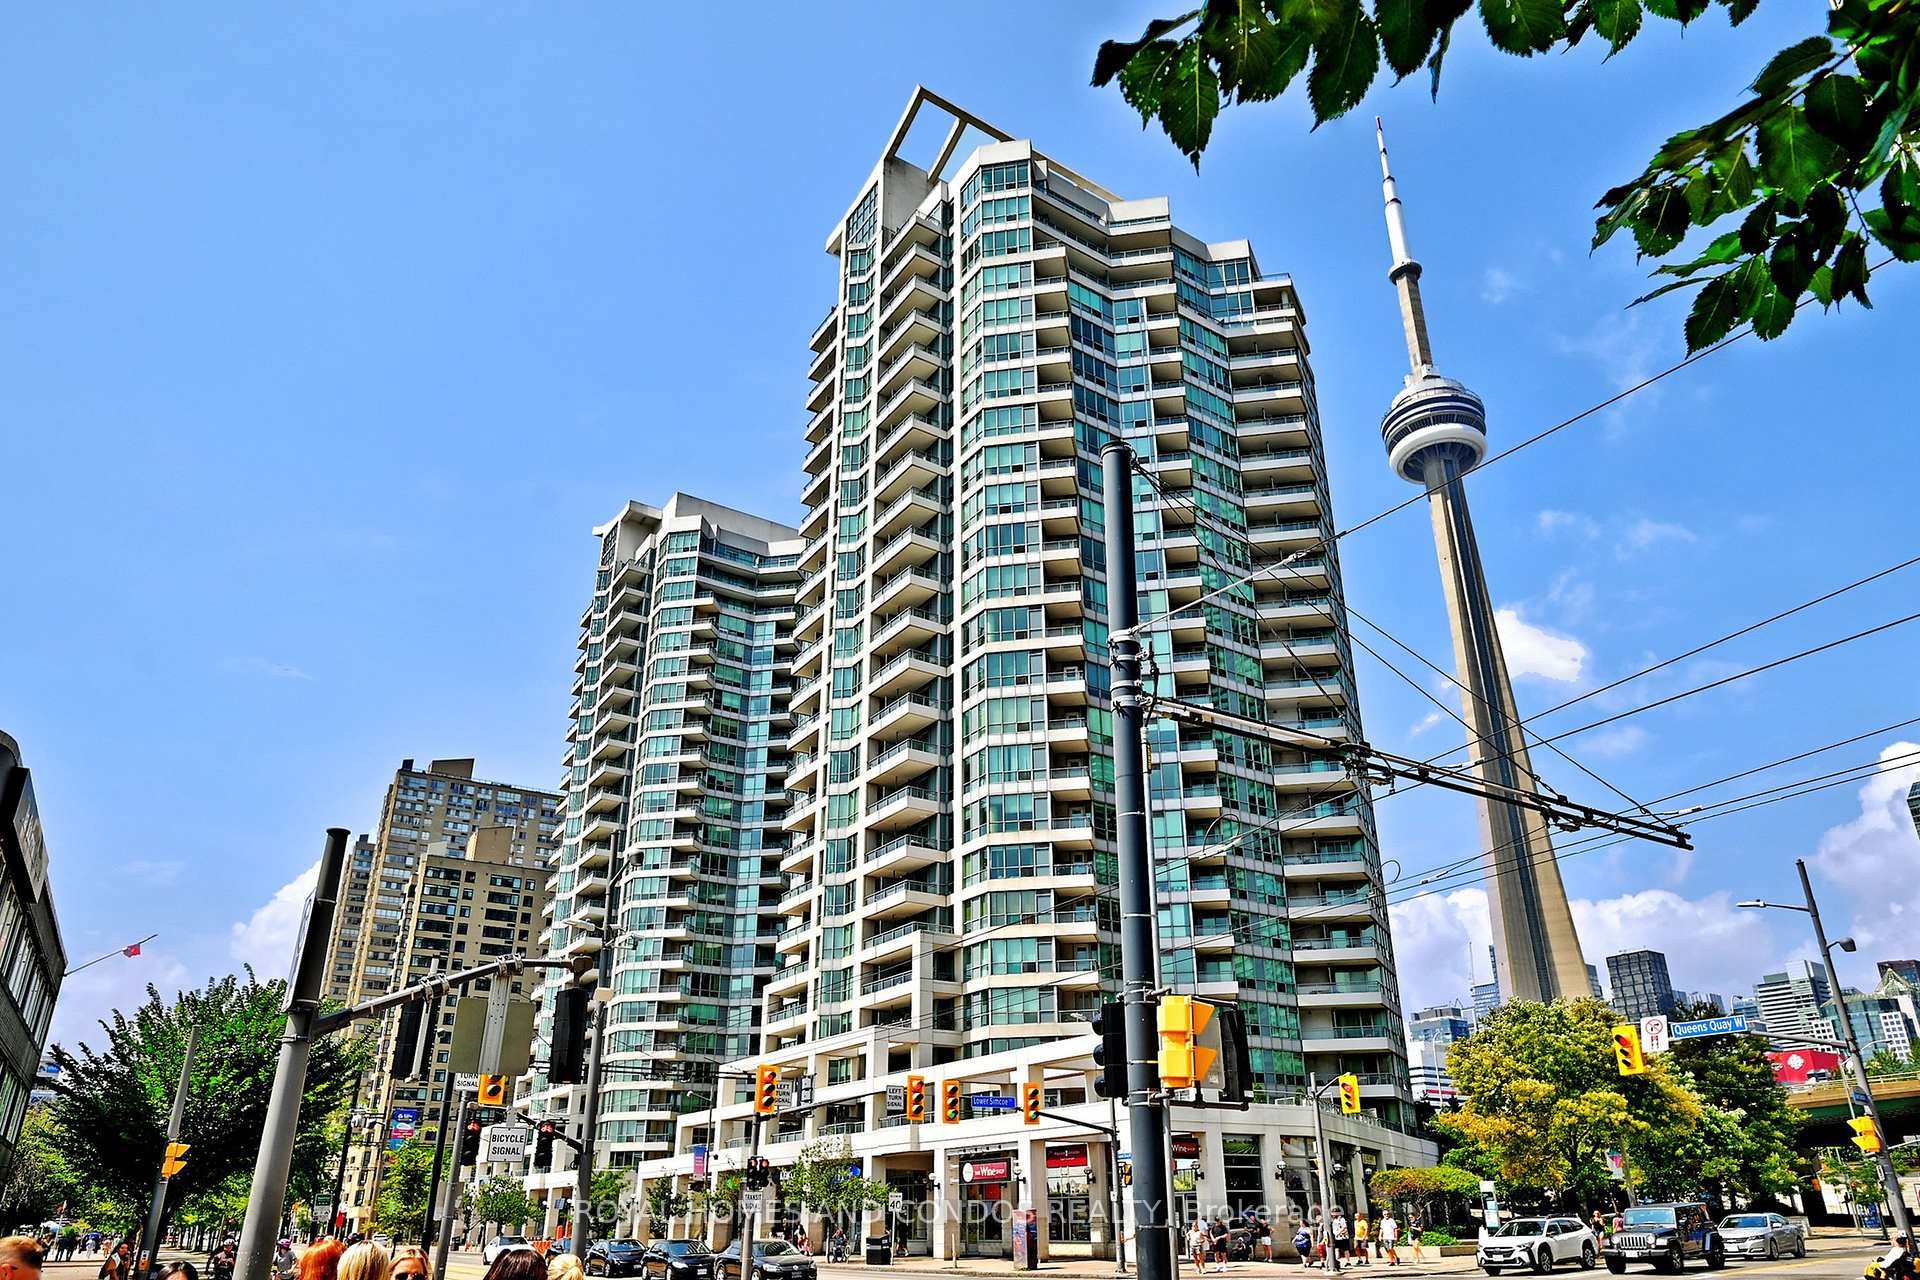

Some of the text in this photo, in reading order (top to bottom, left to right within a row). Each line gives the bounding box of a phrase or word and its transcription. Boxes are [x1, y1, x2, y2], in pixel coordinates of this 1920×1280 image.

[1674, 1016, 1743, 1035] Queens Quay W
[990, 1097, 1009, 1105] Simcoe
[491, 1134, 524, 1143] BICYCLE
[491, 1146, 521, 1155] SIGNAL
[980, 1166, 996, 1176] Wine
[890, 1200, 902, 1210] 40
